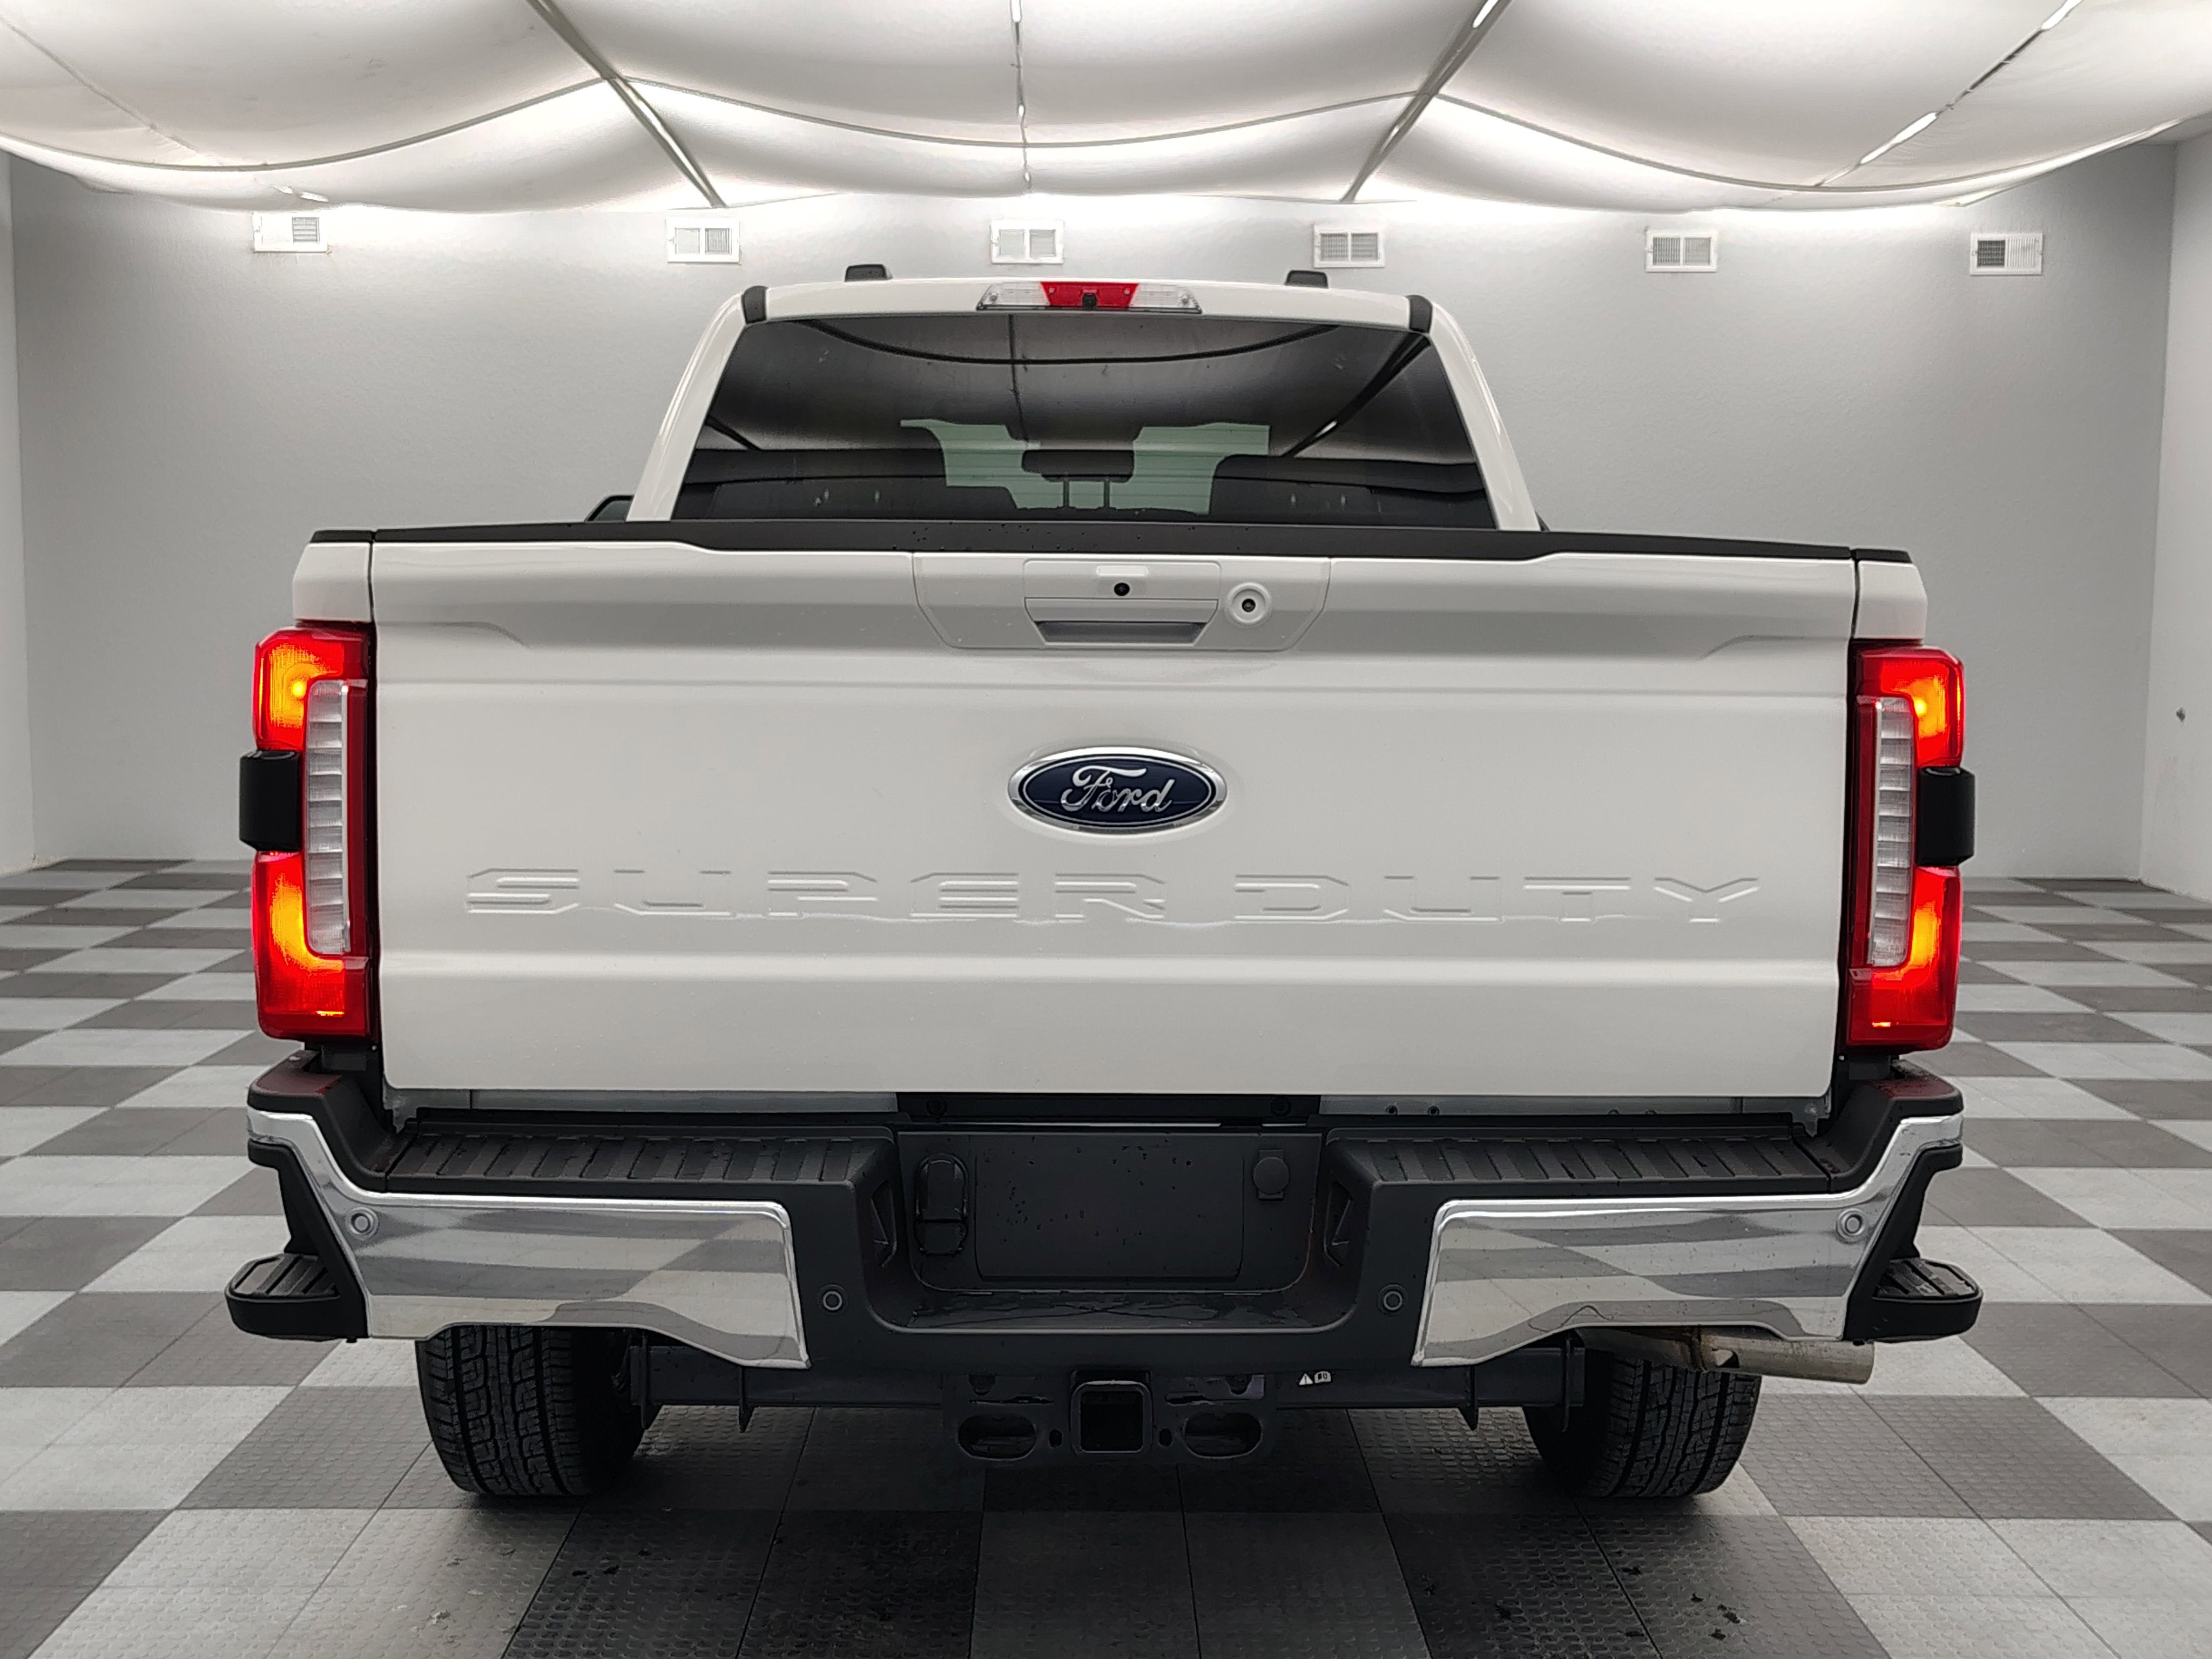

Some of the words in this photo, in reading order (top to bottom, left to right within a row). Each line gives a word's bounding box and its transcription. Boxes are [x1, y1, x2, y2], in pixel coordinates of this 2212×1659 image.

[1060, 765, 1175, 812] Ford
[466, 868, 1161, 921] SUPER
[1233, 873, 1760, 924] DUTY
